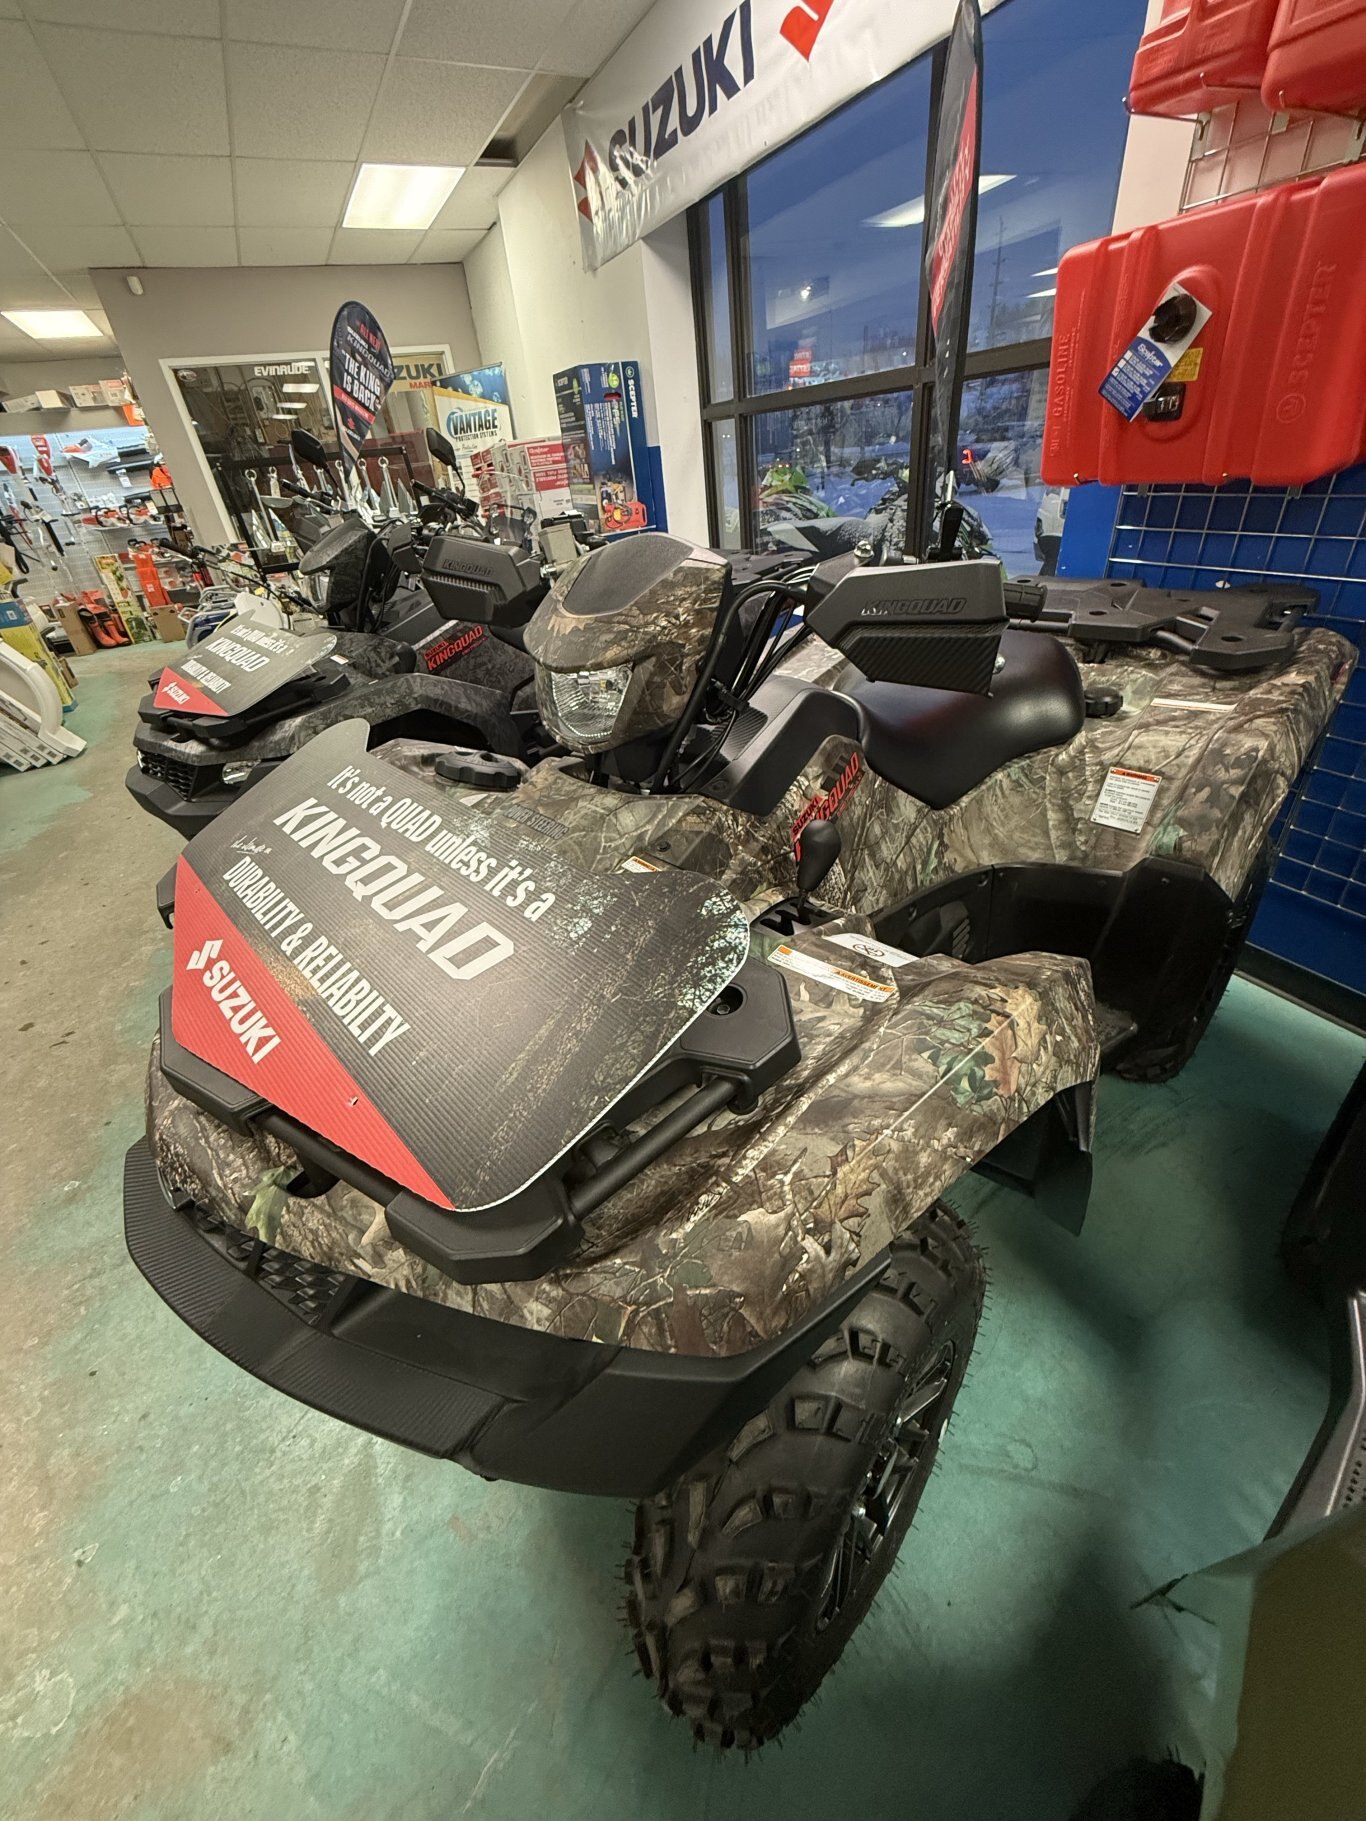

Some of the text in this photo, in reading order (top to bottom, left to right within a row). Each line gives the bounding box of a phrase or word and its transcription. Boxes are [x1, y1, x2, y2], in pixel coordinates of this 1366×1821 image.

[609, 0, 754, 190] SUZUKI
[254, 364, 311, 377] EVINRUDE
[343, 373, 352, 390] IS
[360, 364, 381, 396] KING
[452, 408, 498, 436] VANTAGE
[442, 559, 494, 577] KINGQUAD
[861, 597, 968, 616] KINGQUAD
[205, 636, 271, 672] KINGQUAD
[427, 625, 484, 671] KINGQUAD
[527, 811, 570, 840] STEERING
[792, 797, 819, 836] SUZUKI
[327, 765, 556, 922] It's not a QUAD unless it's a
[222, 856, 305, 938] DURABILITY
[273, 797, 514, 980] KINGQUAD
[281, 923, 314, 955] &
[202, 960, 282, 1065] SUZUKI
[293, 936, 411, 1057] RELIABILTY
